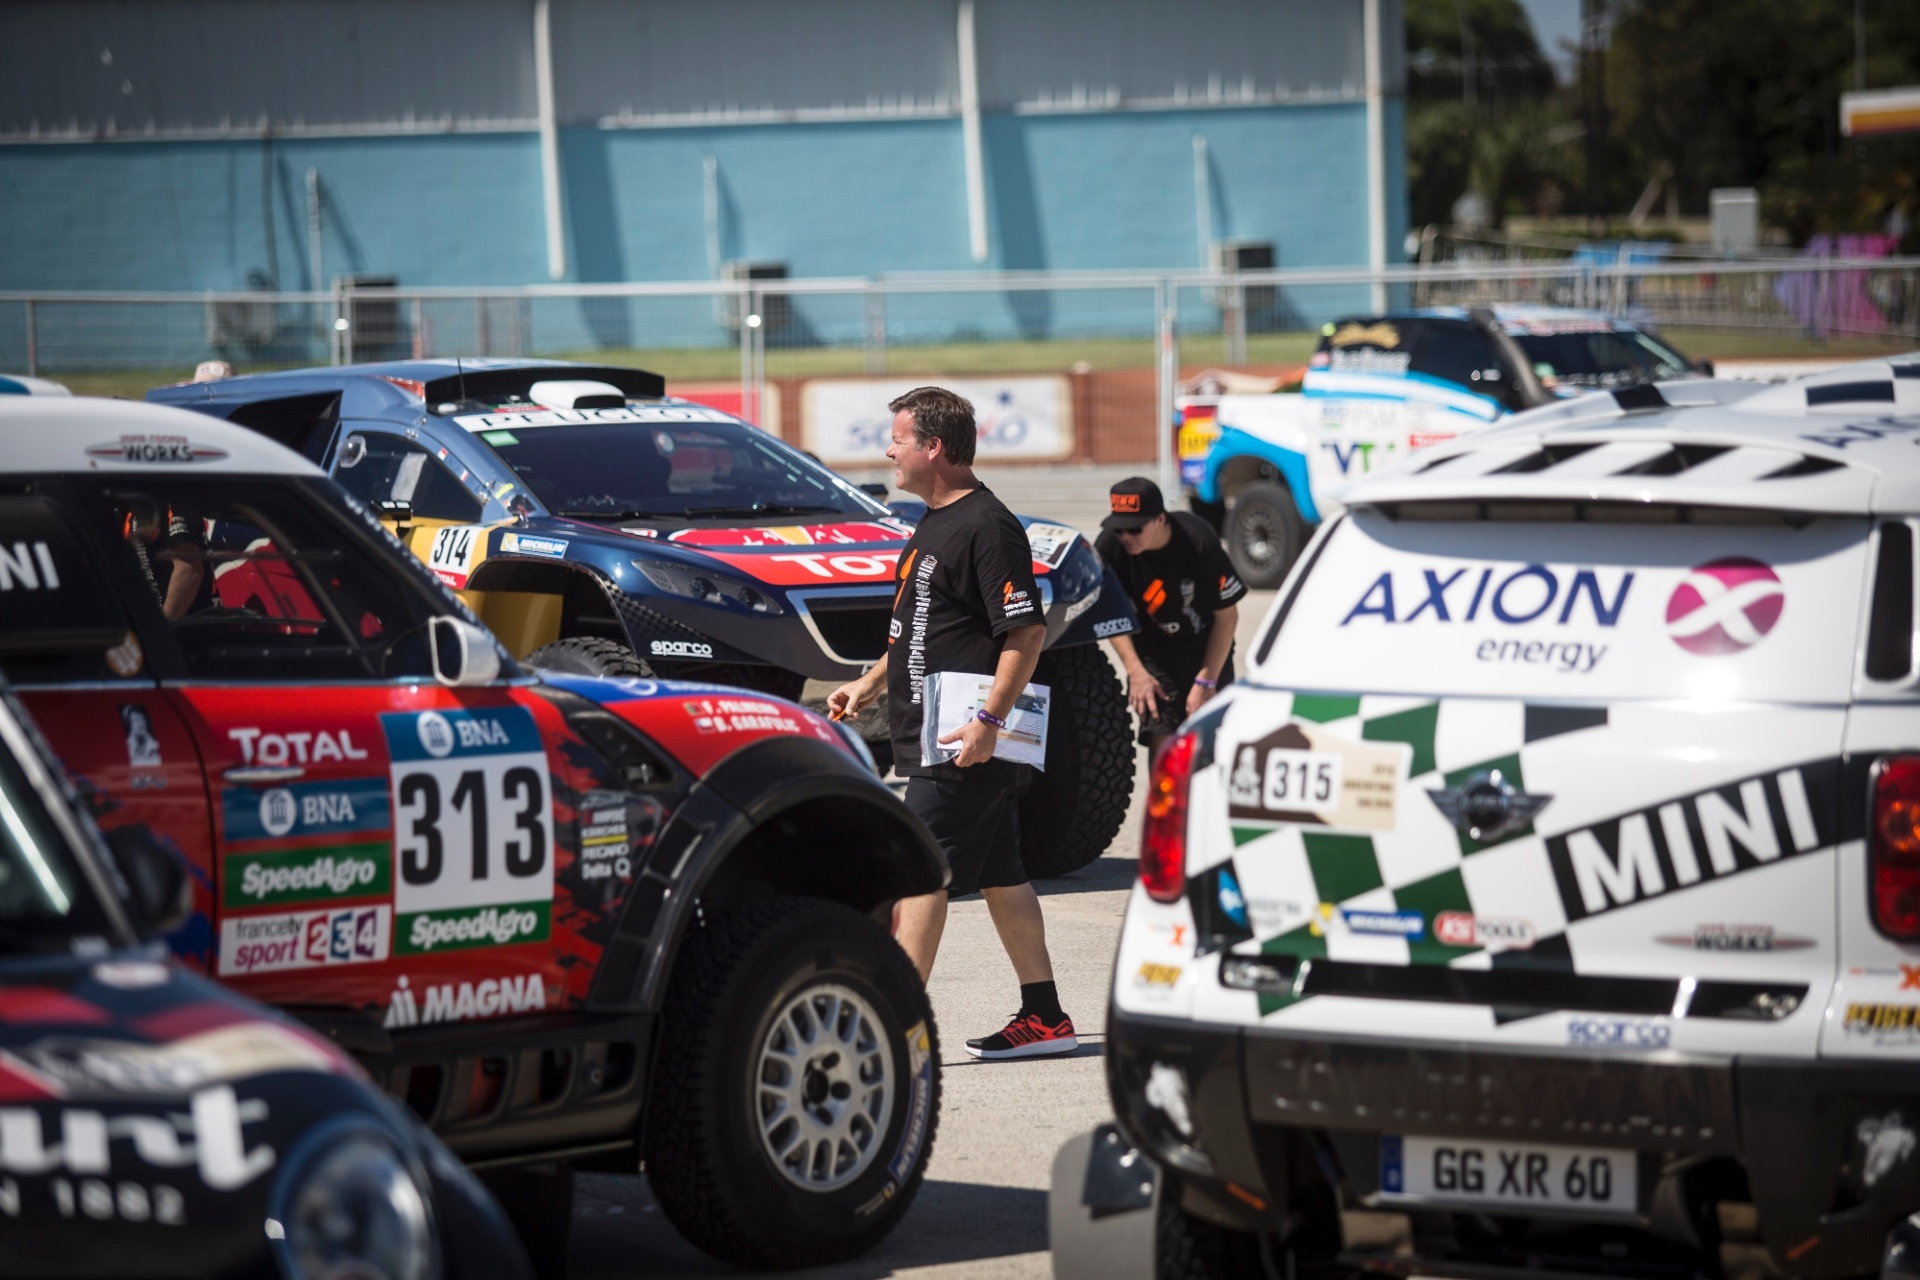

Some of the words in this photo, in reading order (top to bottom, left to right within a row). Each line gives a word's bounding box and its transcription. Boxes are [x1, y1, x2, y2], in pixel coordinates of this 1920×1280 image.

[123, 444, 194, 461] WORKS
[433, 528, 470, 567] 314
[519, 539, 567, 553] MICHELIN
[1339, 564, 1635, 628] AXION
[650, 641, 713, 658] sparco
[1475, 636, 1608, 672] energy
[229, 728, 368, 764] TOTAL
[456, 720, 509, 748] BNA
[1273, 761, 1331, 802] 315
[304, 795, 356, 824] BNA
[399, 766, 547, 887] 313
[1566, 768, 1820, 914] MINI
[241, 857, 377, 899] SpeedAgro
[582, 863, 612, 879] Delta
[236, 917, 302, 941] francetv
[410, 909, 538, 950] SpeedAgro
[1347, 911, 1424, 935] MICHELIN
[1476, 922, 1528, 940] TOOLS
[234, 933, 299, 971] sport
[422, 974, 546, 1023] MAGNA
[1567, 1017, 1672, 1046] sparco
[1433, 1147, 1485, 1193] GG
[1498, 1151, 1549, 1198] XR
[1564, 1156, 1612, 1202] 60
